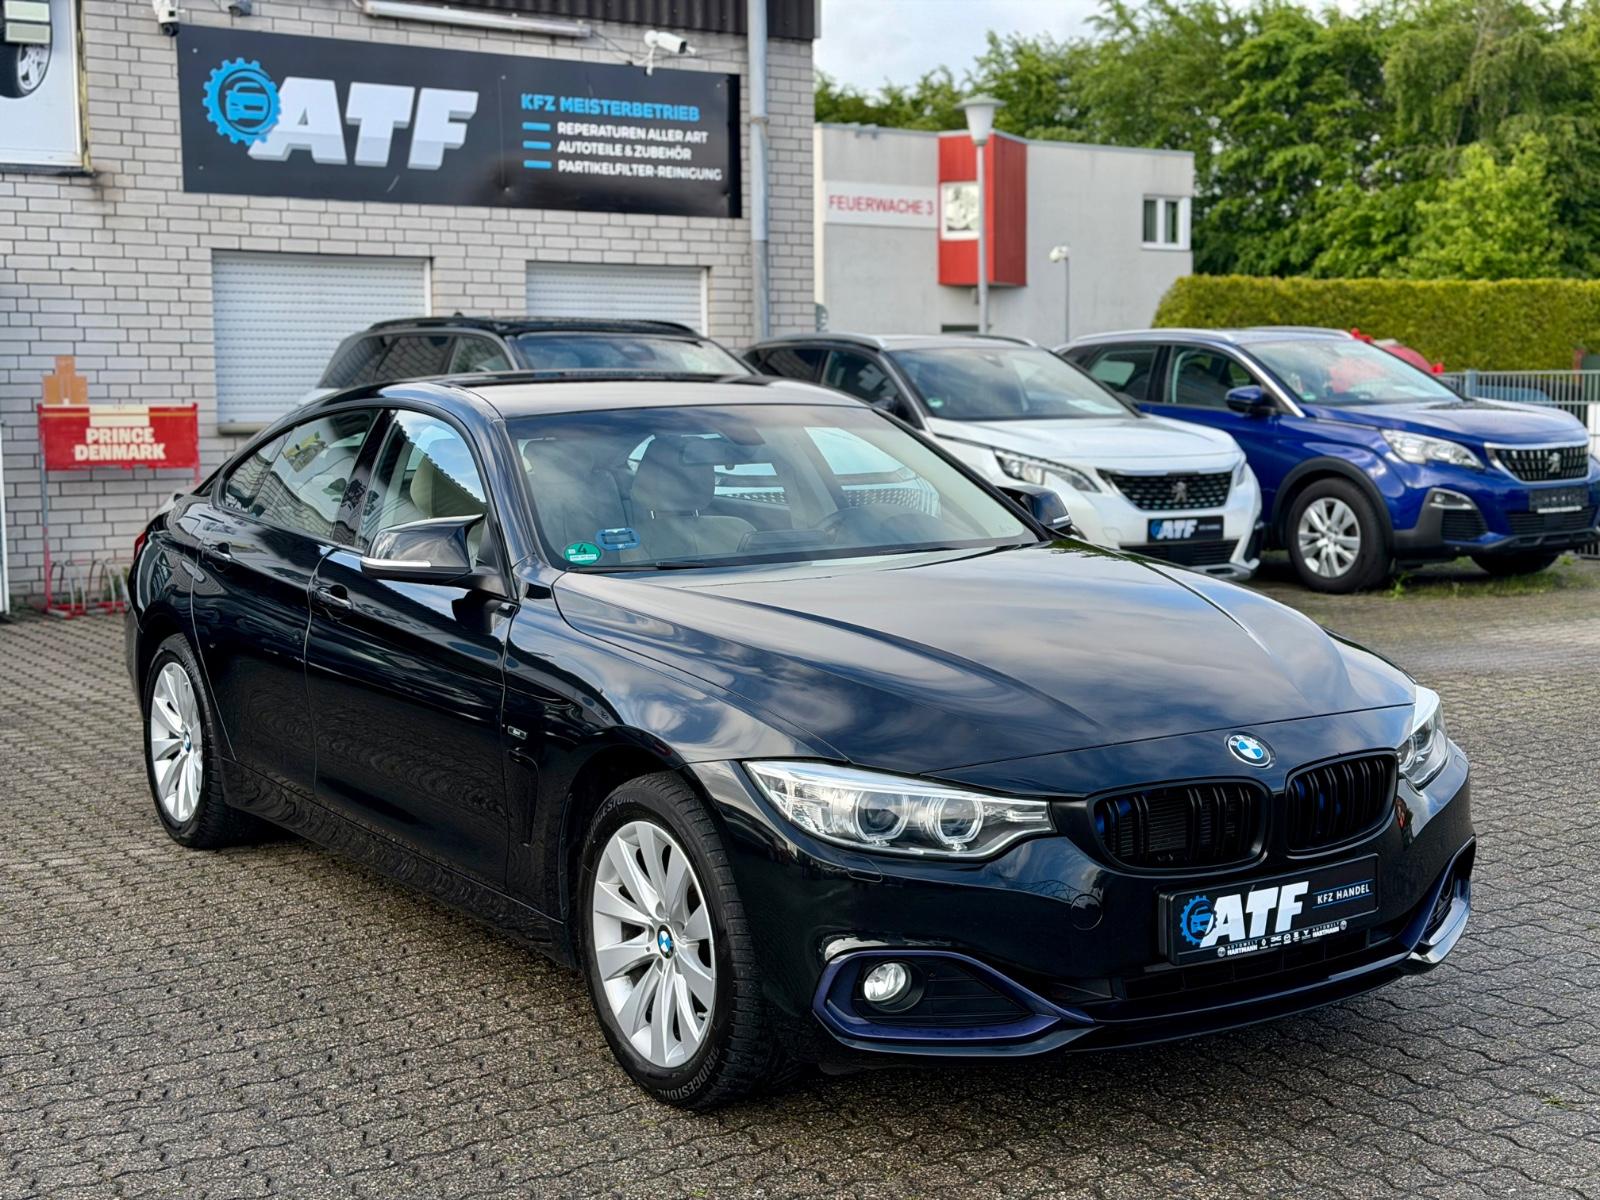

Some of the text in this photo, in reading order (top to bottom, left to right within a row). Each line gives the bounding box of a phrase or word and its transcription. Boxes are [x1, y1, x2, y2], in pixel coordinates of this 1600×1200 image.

[520, 93, 700, 122] KFZ MEISTERBETRIEB
[248, 76, 479, 169] ATF
[557, 121, 709, 144] REPERATUREN ALLER ART
[557, 140, 692, 160] AUTOTEILE & ZUBEHÖR
[558, 159, 723, 181] PARTIKELFILTER-REINIGUNG
[829, 195, 935, 216] FEUERWACHE 3
[85, 427, 155, 444] PRINCE
[74, 443, 166, 461] DENMARK
[1156, 519, 1198, 540] ATF
[577, 544, 587, 554] 4
[1317, 883, 1370, 905] KFZ HANDEL
[1200, 881, 1310, 948] ATF
